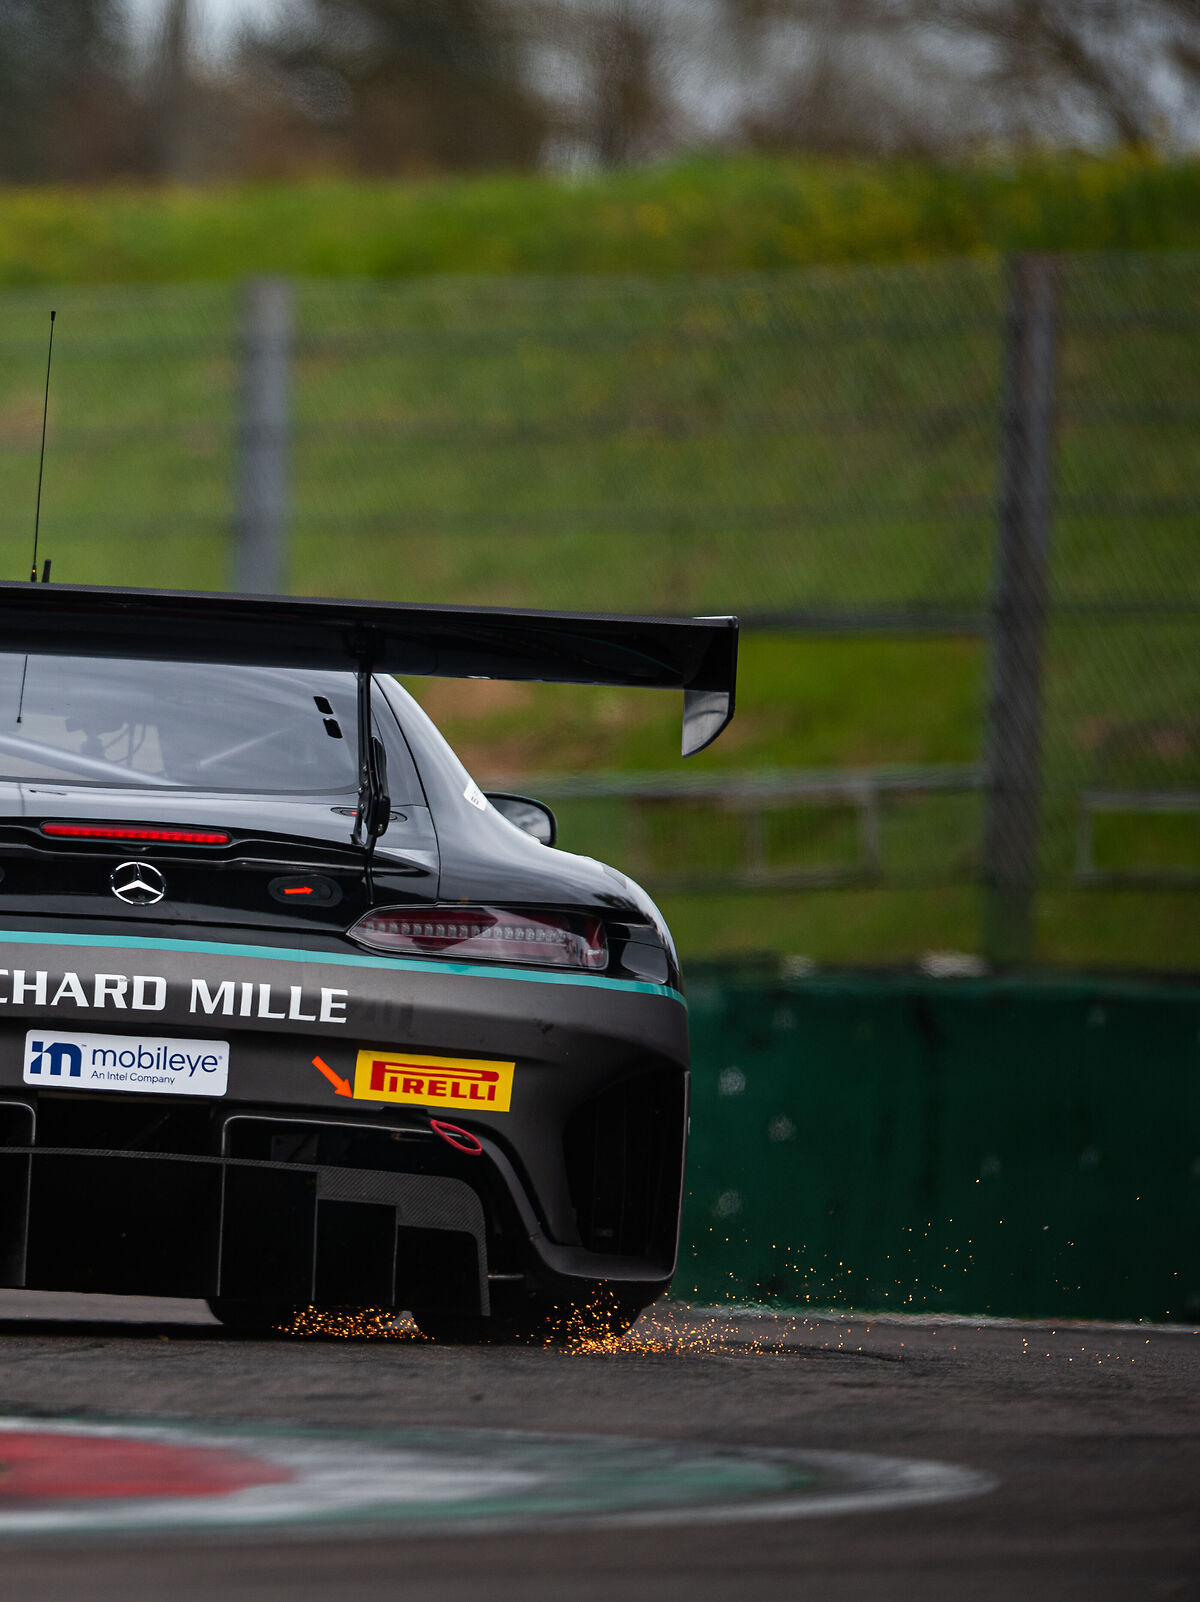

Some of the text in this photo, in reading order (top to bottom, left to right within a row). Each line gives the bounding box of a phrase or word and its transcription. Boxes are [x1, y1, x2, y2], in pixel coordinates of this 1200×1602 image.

[189, 978, 349, 1024] MILLE
[90, 1070, 176, 1085] An Intel Company
[91, 1044, 218, 1077] mobileye
[370, 1060, 499, 1101] PIRELLI
